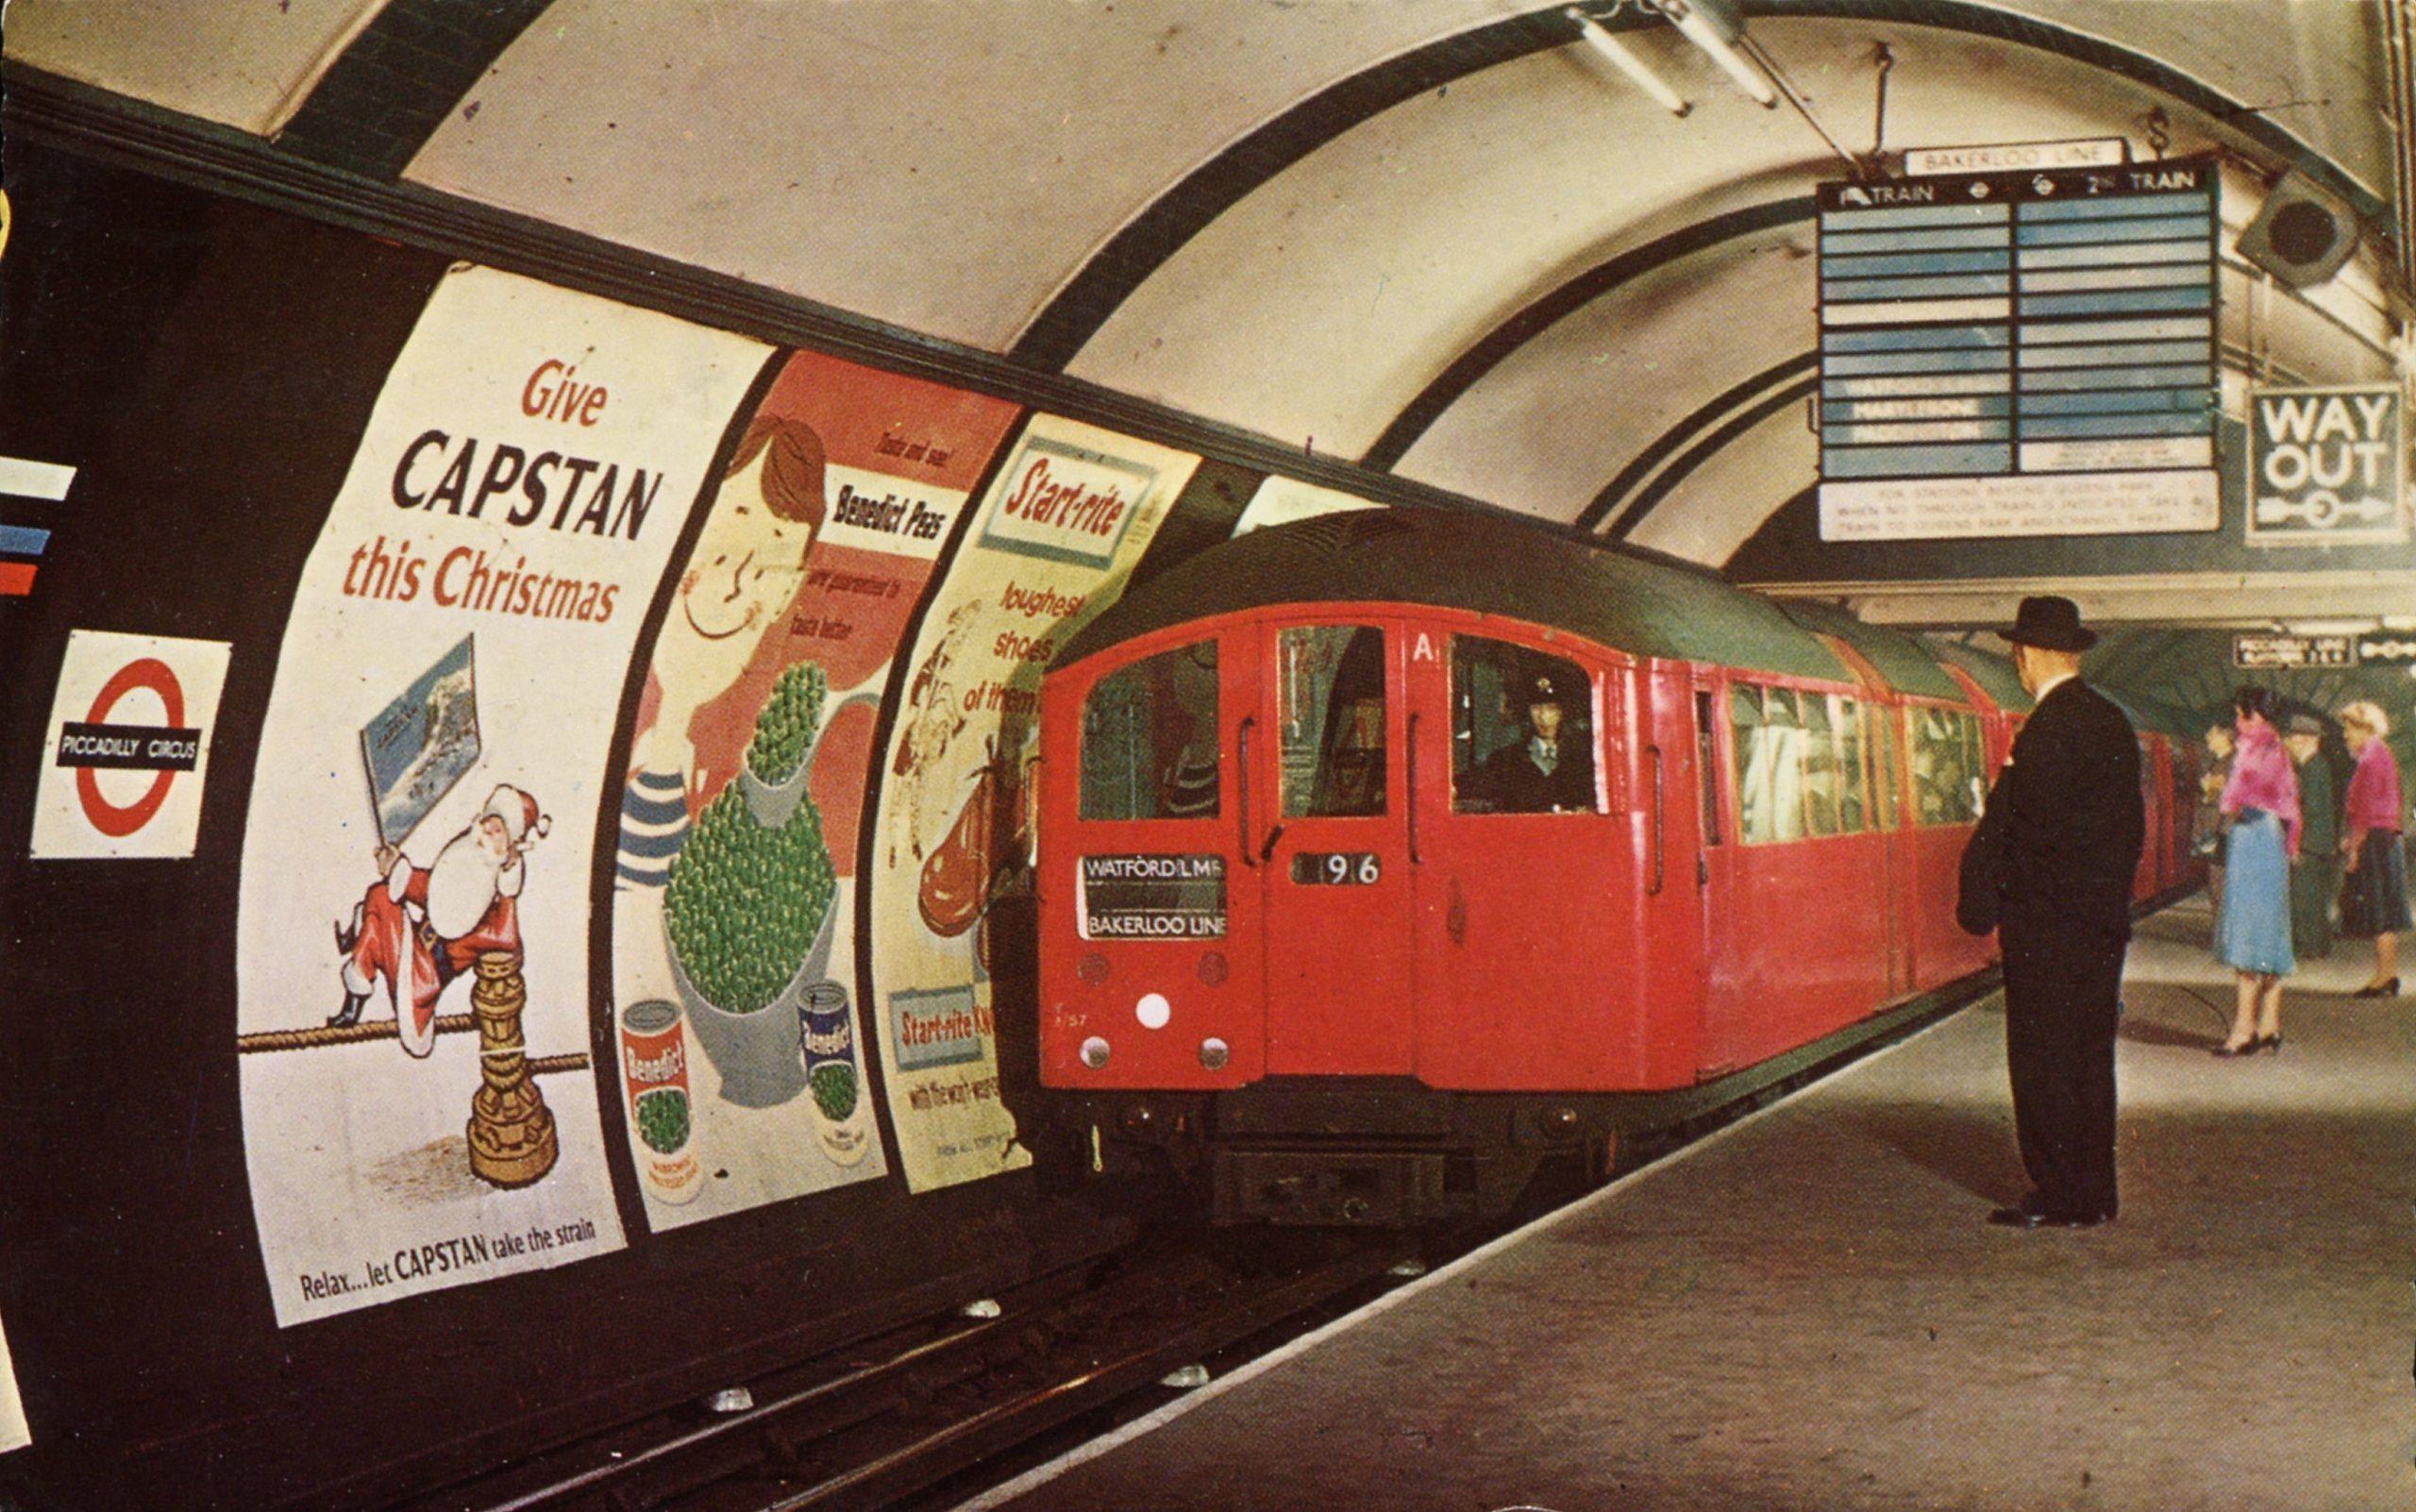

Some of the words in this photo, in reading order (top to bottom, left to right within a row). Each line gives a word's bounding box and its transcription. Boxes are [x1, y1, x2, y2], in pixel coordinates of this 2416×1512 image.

[1924, 148, 2038, 170] BAKERLOO
[2054, 145, 2103, 163] LINE
[1871, 184, 1935, 203] TRAIN
[2130, 170, 2196, 190] TRAIN
[521, 359, 609, 428] Give
[2260, 395, 2391, 443] WAY
[2264, 442, 2389, 490] OUT
[391, 428, 664, 542] CAPSTAN
[1004, 458, 1126, 537] Start-rite
[832, 484, 909, 534] Benedict
[902, 500, 947, 541] Peas
[343, 535, 427, 602] this
[432, 546, 620, 623] Christmas
[999, 580, 1087, 617] toughest
[994, 630, 1053, 661] shoes
[1414, 632, 1434, 661] A
[963, 680, 988, 711] of
[985, 685, 1036, 715] them
[61, 735, 140, 757] PICCADILLY
[148, 739, 196, 760] CIRCUS
[1085, 858, 1177, 878] WATFORD
[1329, 854, 1379, 884] 96
[1088, 916, 1185, 934] BAKERLOO
[1190, 916, 1227, 935] LINE
[901, 1008, 973, 1049] Start-rite
[626, 1039, 684, 1084] Benedict
[394, 1234, 489, 1282] CAPSTAN
[491, 1232, 525, 1259] take
[527, 1226, 554, 1252] the
[555, 1218, 596, 1247] strain
